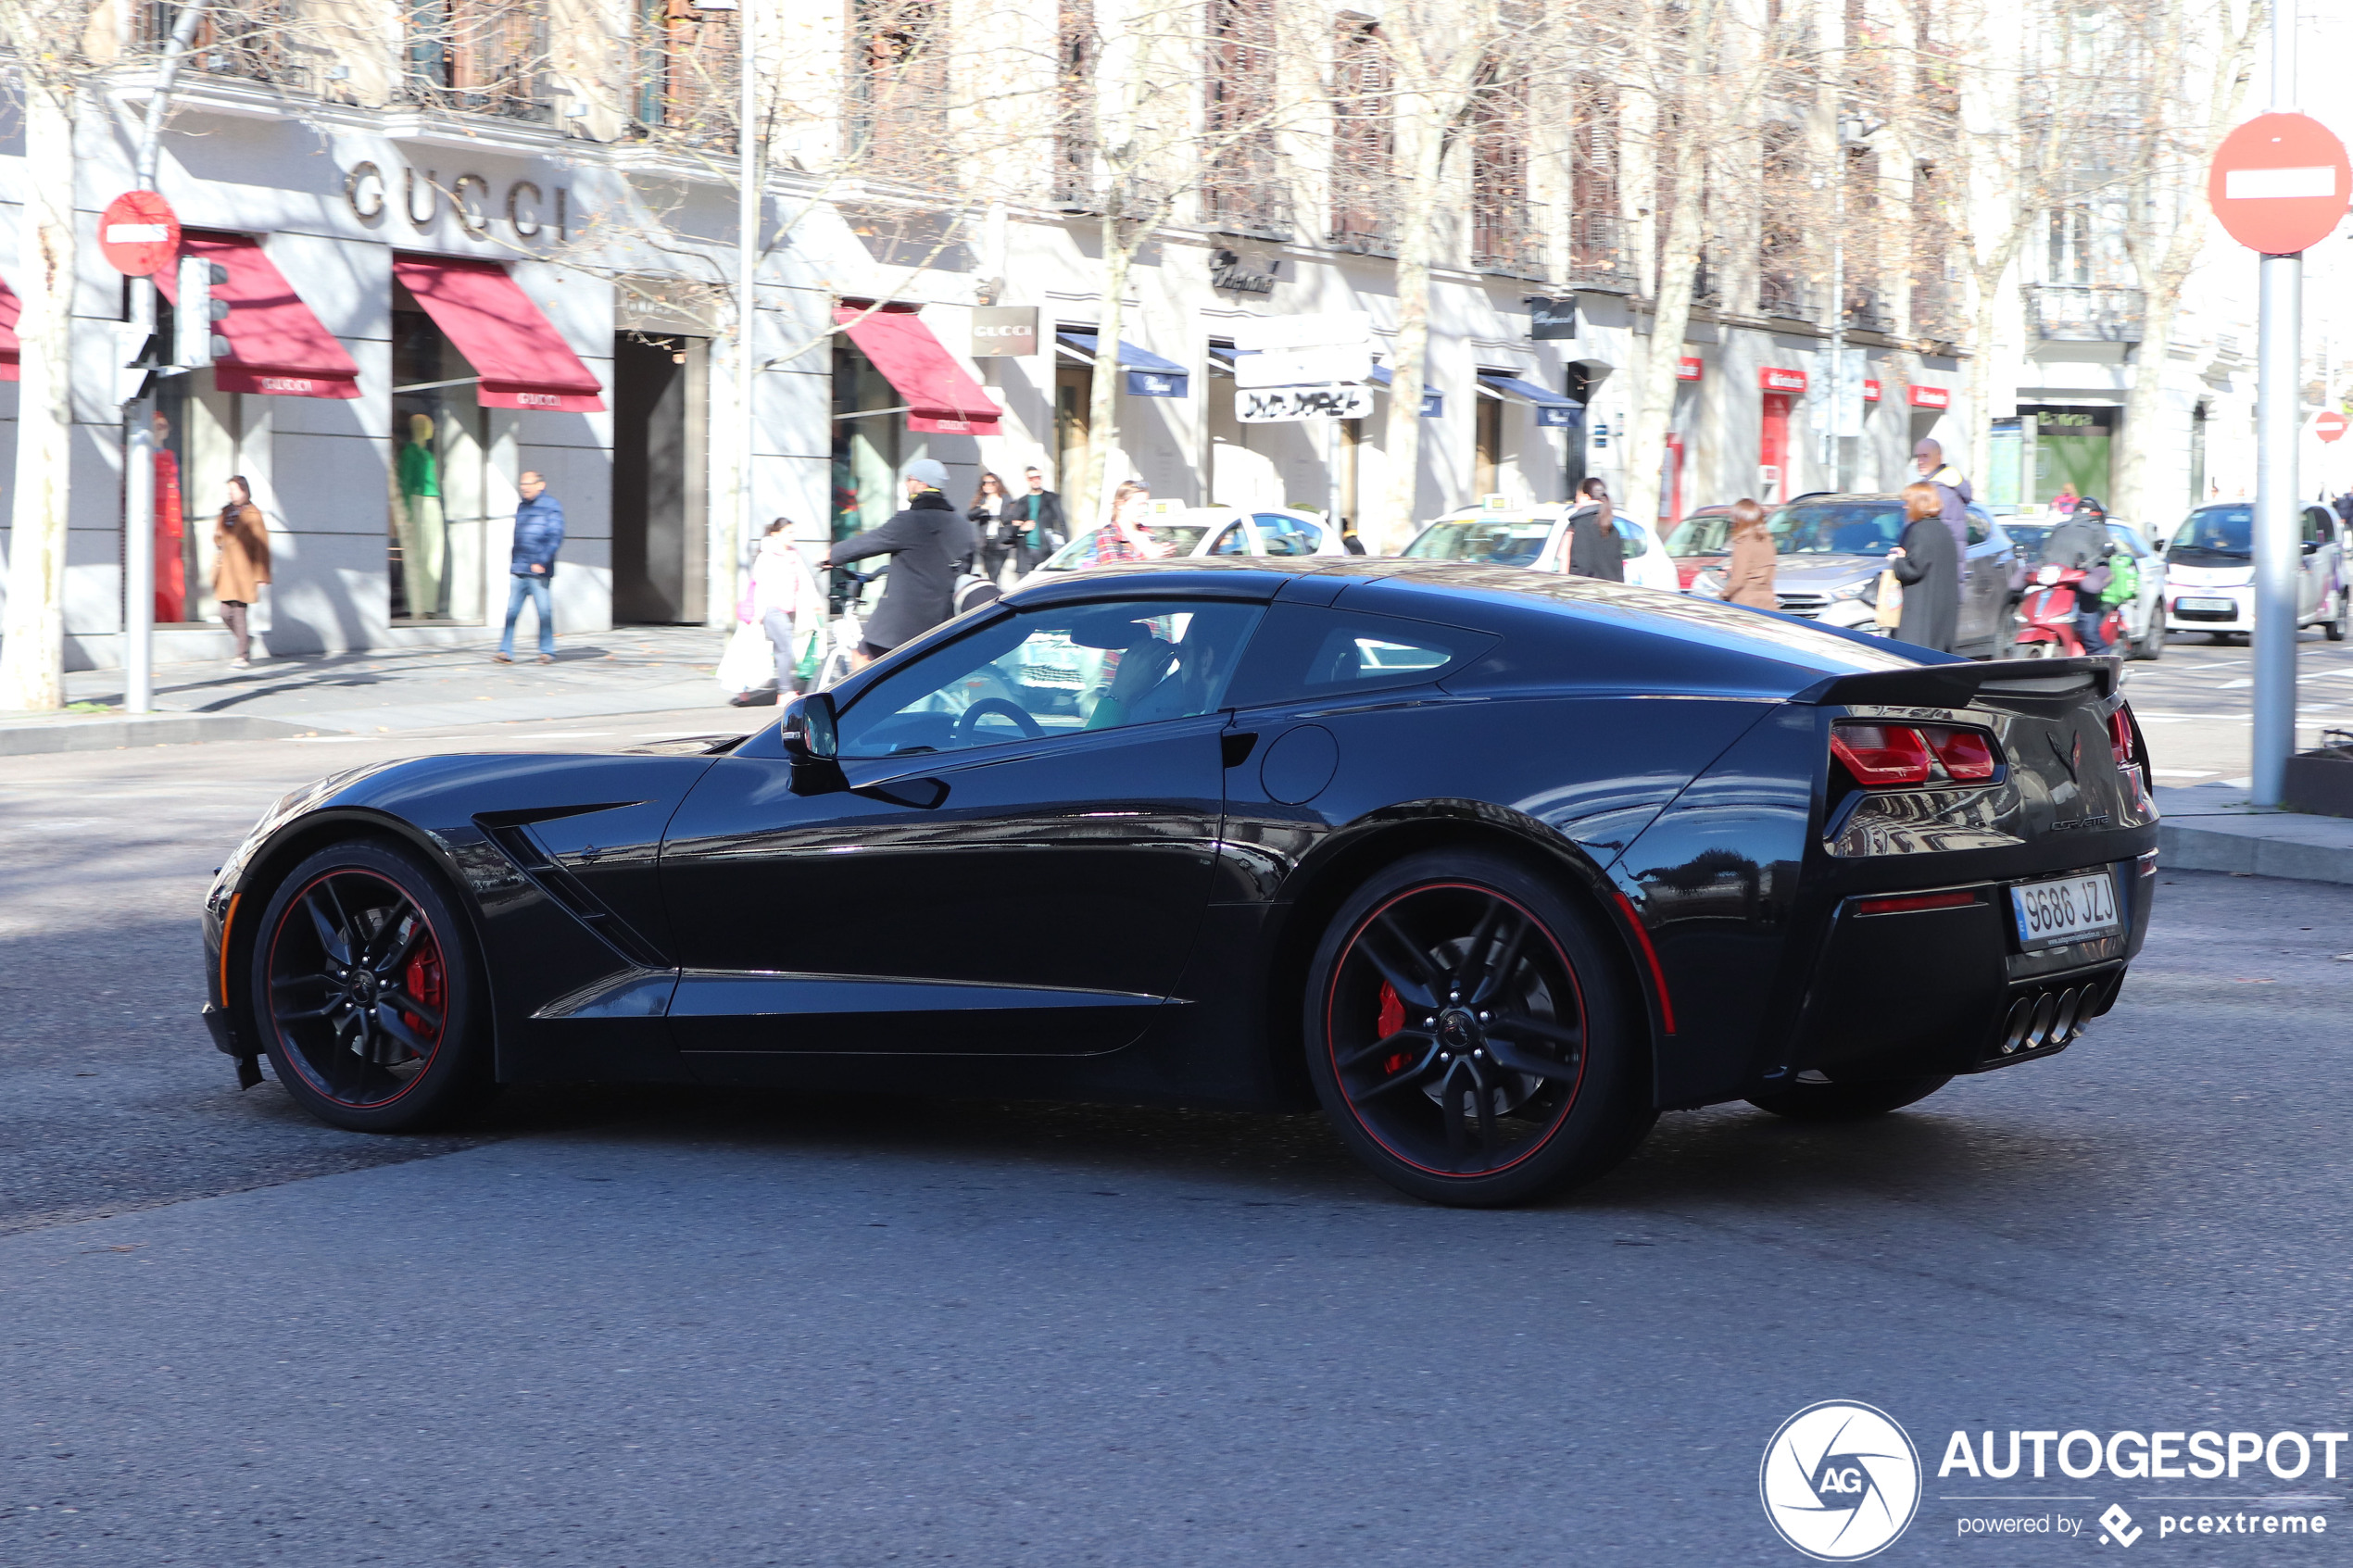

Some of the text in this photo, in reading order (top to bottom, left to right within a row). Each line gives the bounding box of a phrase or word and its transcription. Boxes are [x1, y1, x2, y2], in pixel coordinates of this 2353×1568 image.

[344, 160, 568, 243] GUCCI
[2025, 878, 2113, 933] 9686 JZJ
